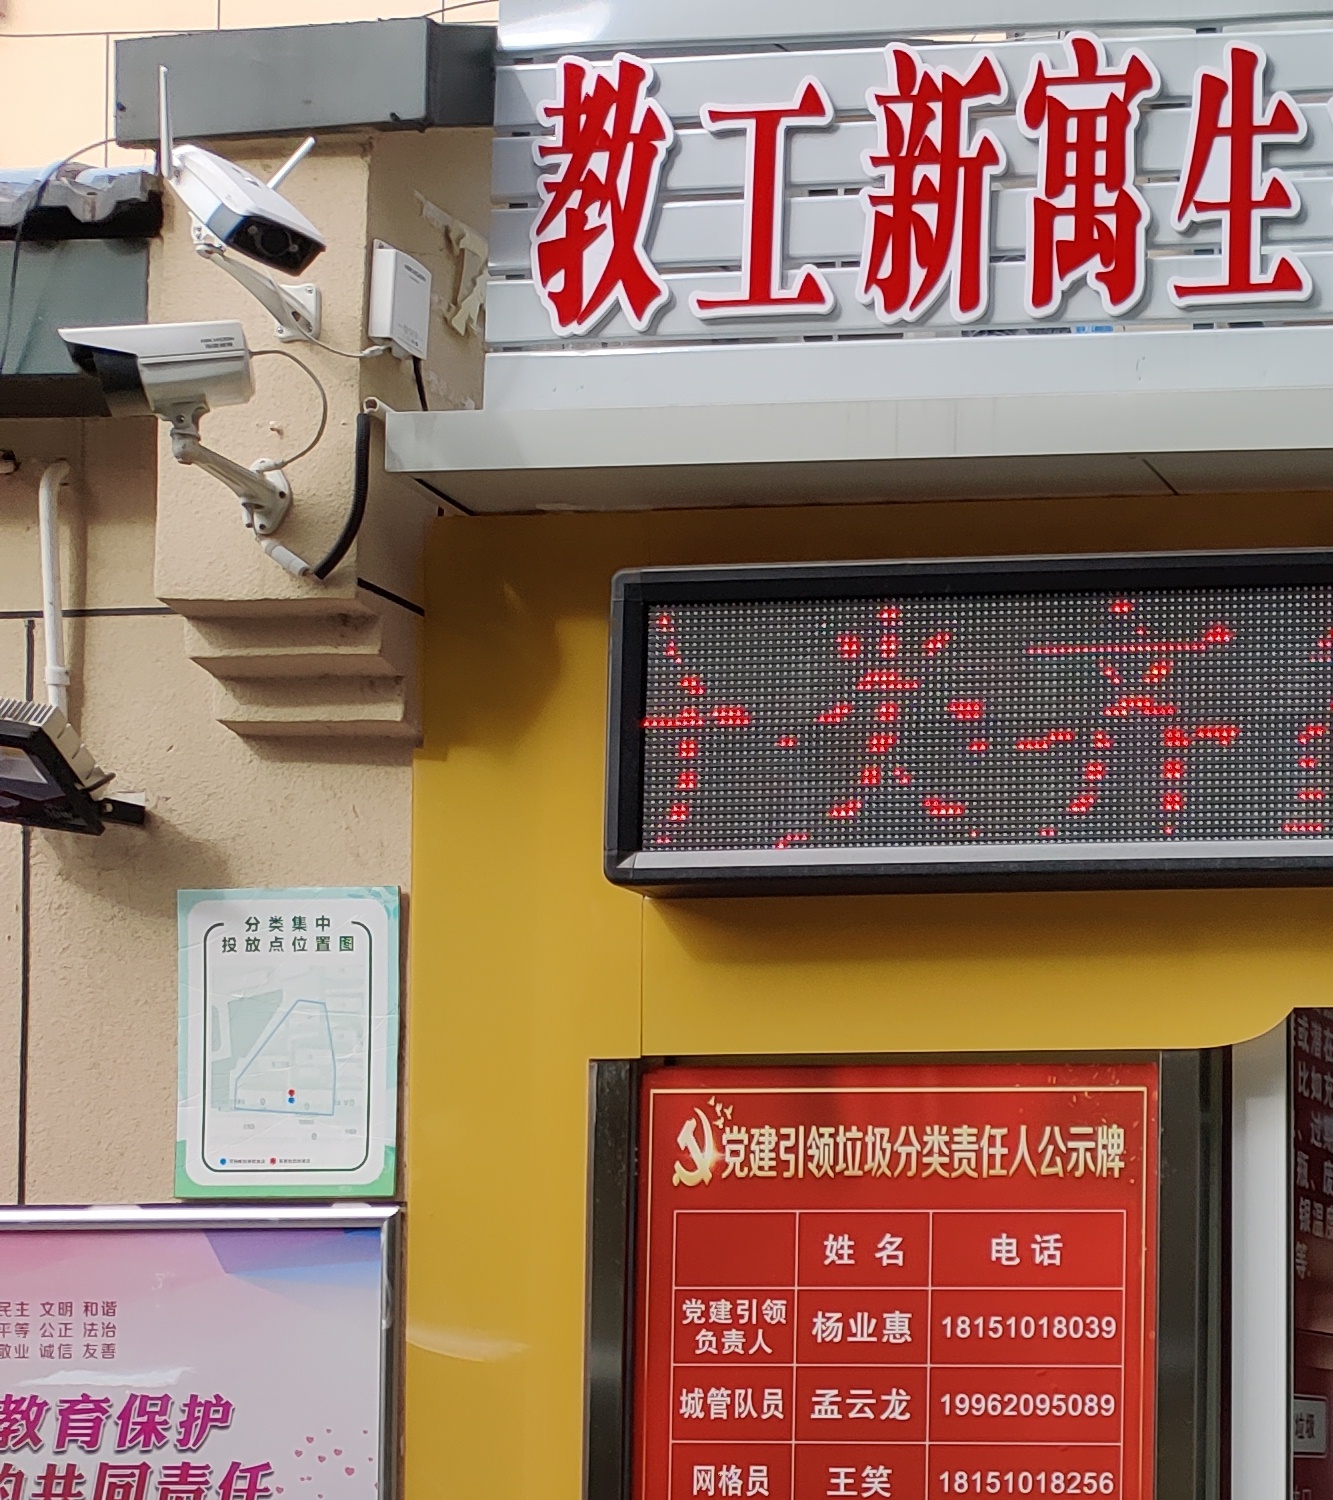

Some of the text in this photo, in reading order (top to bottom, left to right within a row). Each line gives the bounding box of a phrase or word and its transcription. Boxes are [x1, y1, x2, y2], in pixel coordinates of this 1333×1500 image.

[245, 916, 331, 932] 分类集中
[222, 936, 354, 953] 投放点位置图
[721, 1125, 1125, 1180] 党建引领垃圾分类责任人公示牌
[990, 1233, 1064, 1265] 电话
[39, 1301, 73, 1318] 文明
[83, 1301, 117, 1318] 和谐
[682, 1299, 788, 1325] 党建引领
[39, 1322, 73, 1339] 公正
[83, 1322, 117, 1339] 法治
[812, 1311, 913, 1344] 杨业惠
[941, 1315, 1117, 1340] 18151018039
[39, 1343, 73, 1360] 诚信
[83, 1343, 117, 1360] 友善
[694, 1328, 773, 1355] 负责人
[679, 1387, 784, 1421] 城管队员
[811, 1388, 911, 1421] 孟云龙
[941, 1393, 1115, 1417] 19962095089
[692, 1464, 769, 1498] 网格员
[827, 1466, 893, 1499] 王笑
[938, 1471, 1114, 1495] 18151018256
